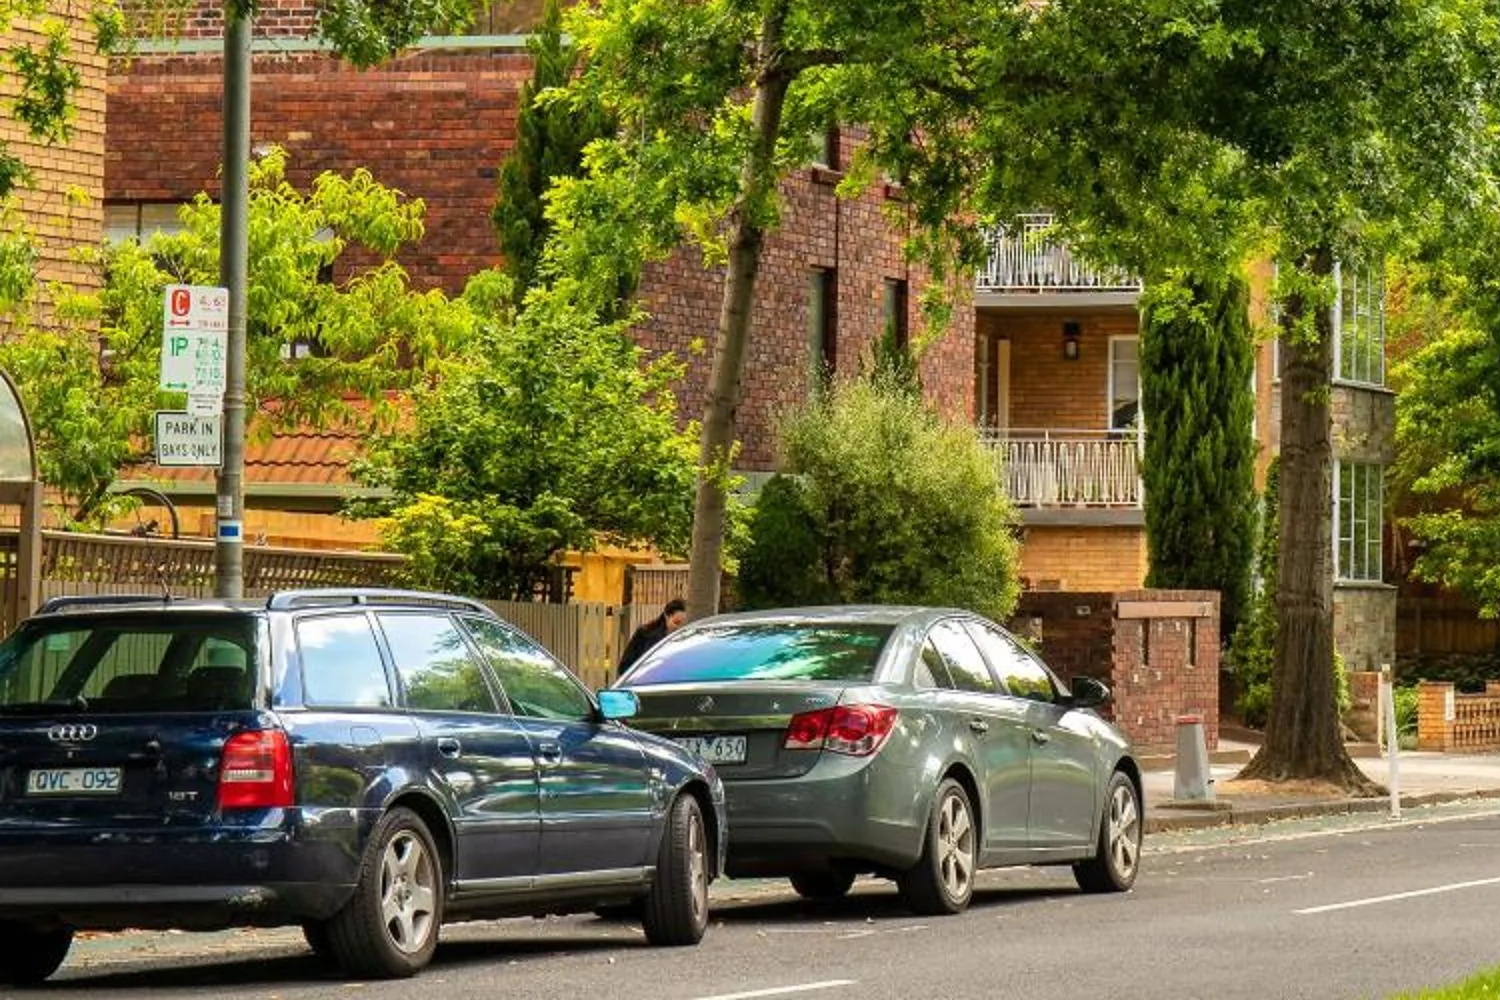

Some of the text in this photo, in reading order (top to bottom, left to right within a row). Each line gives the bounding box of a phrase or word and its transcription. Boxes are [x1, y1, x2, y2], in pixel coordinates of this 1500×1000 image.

[170, 337, 189, 357] 1P
[165, 421, 213, 436] PARK IN
[161, 443, 218, 457] BAYS ONLY
